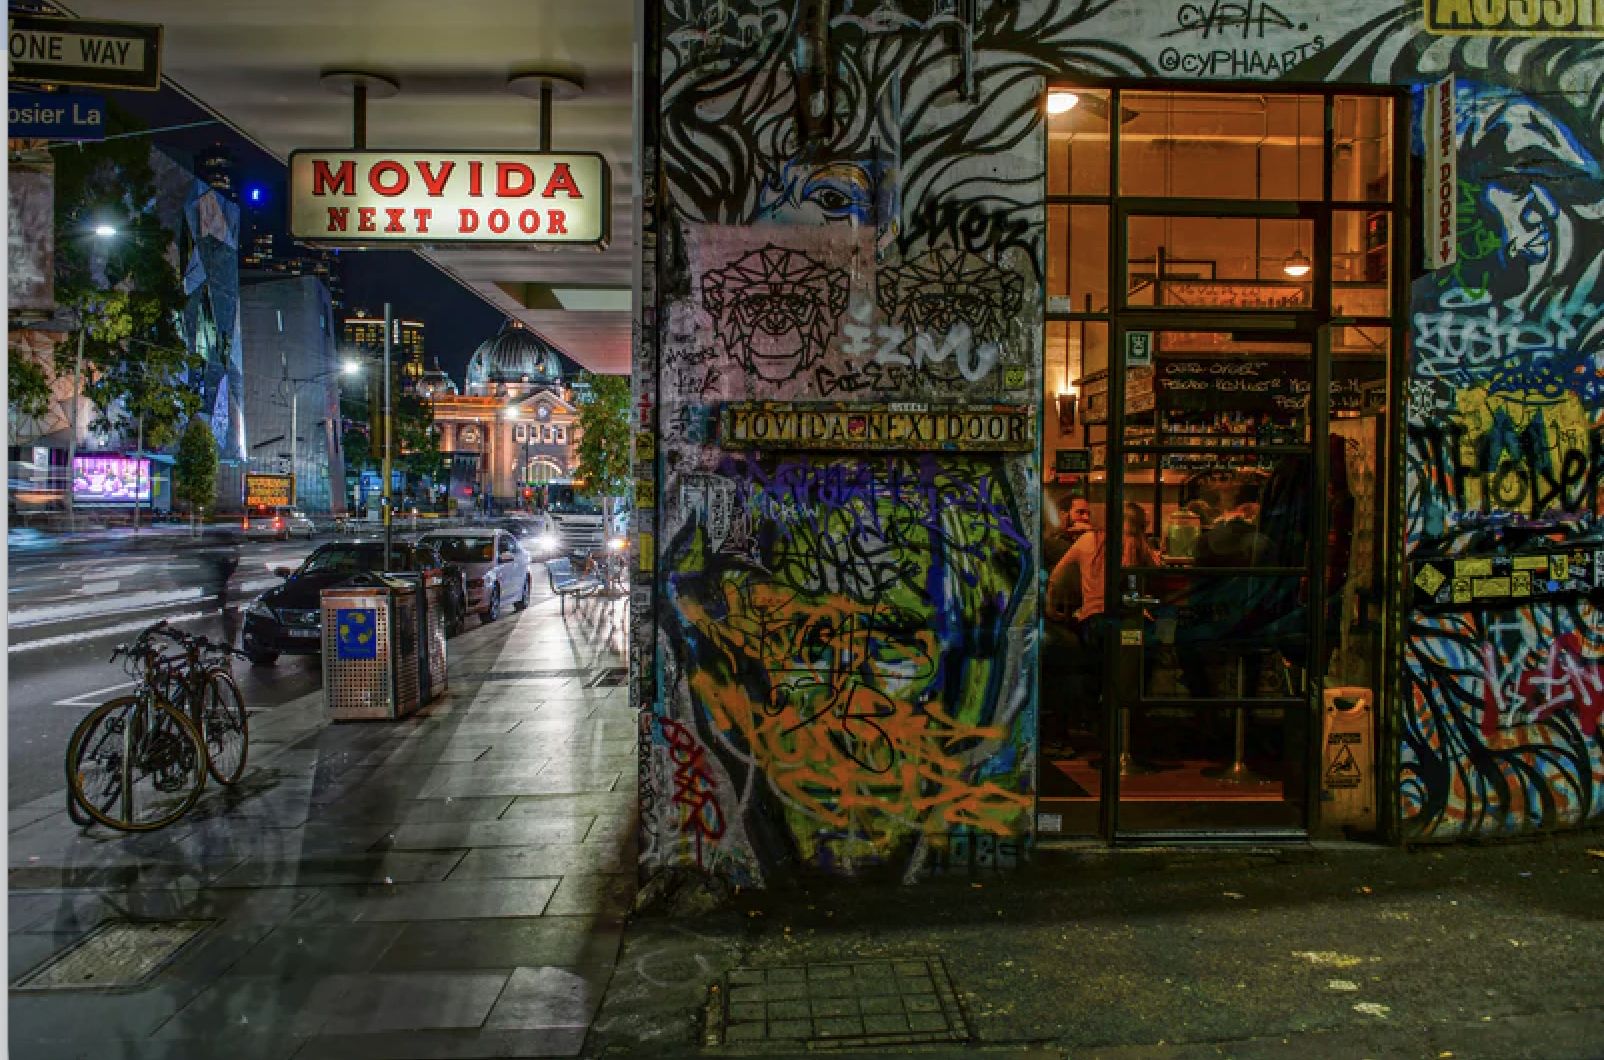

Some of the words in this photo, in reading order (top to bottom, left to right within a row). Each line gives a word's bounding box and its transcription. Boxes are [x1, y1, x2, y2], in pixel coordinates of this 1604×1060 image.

[10, 32, 62, 60] ONE
[80, 38, 130, 66] WAY
[73, 103, 101, 125] La
[311, 160, 584, 198] MOVIDA
[1440, 163, 1451, 239] DOOR
[327, 207, 433, 233] NEXT
[458, 208, 568, 234] DOOR
